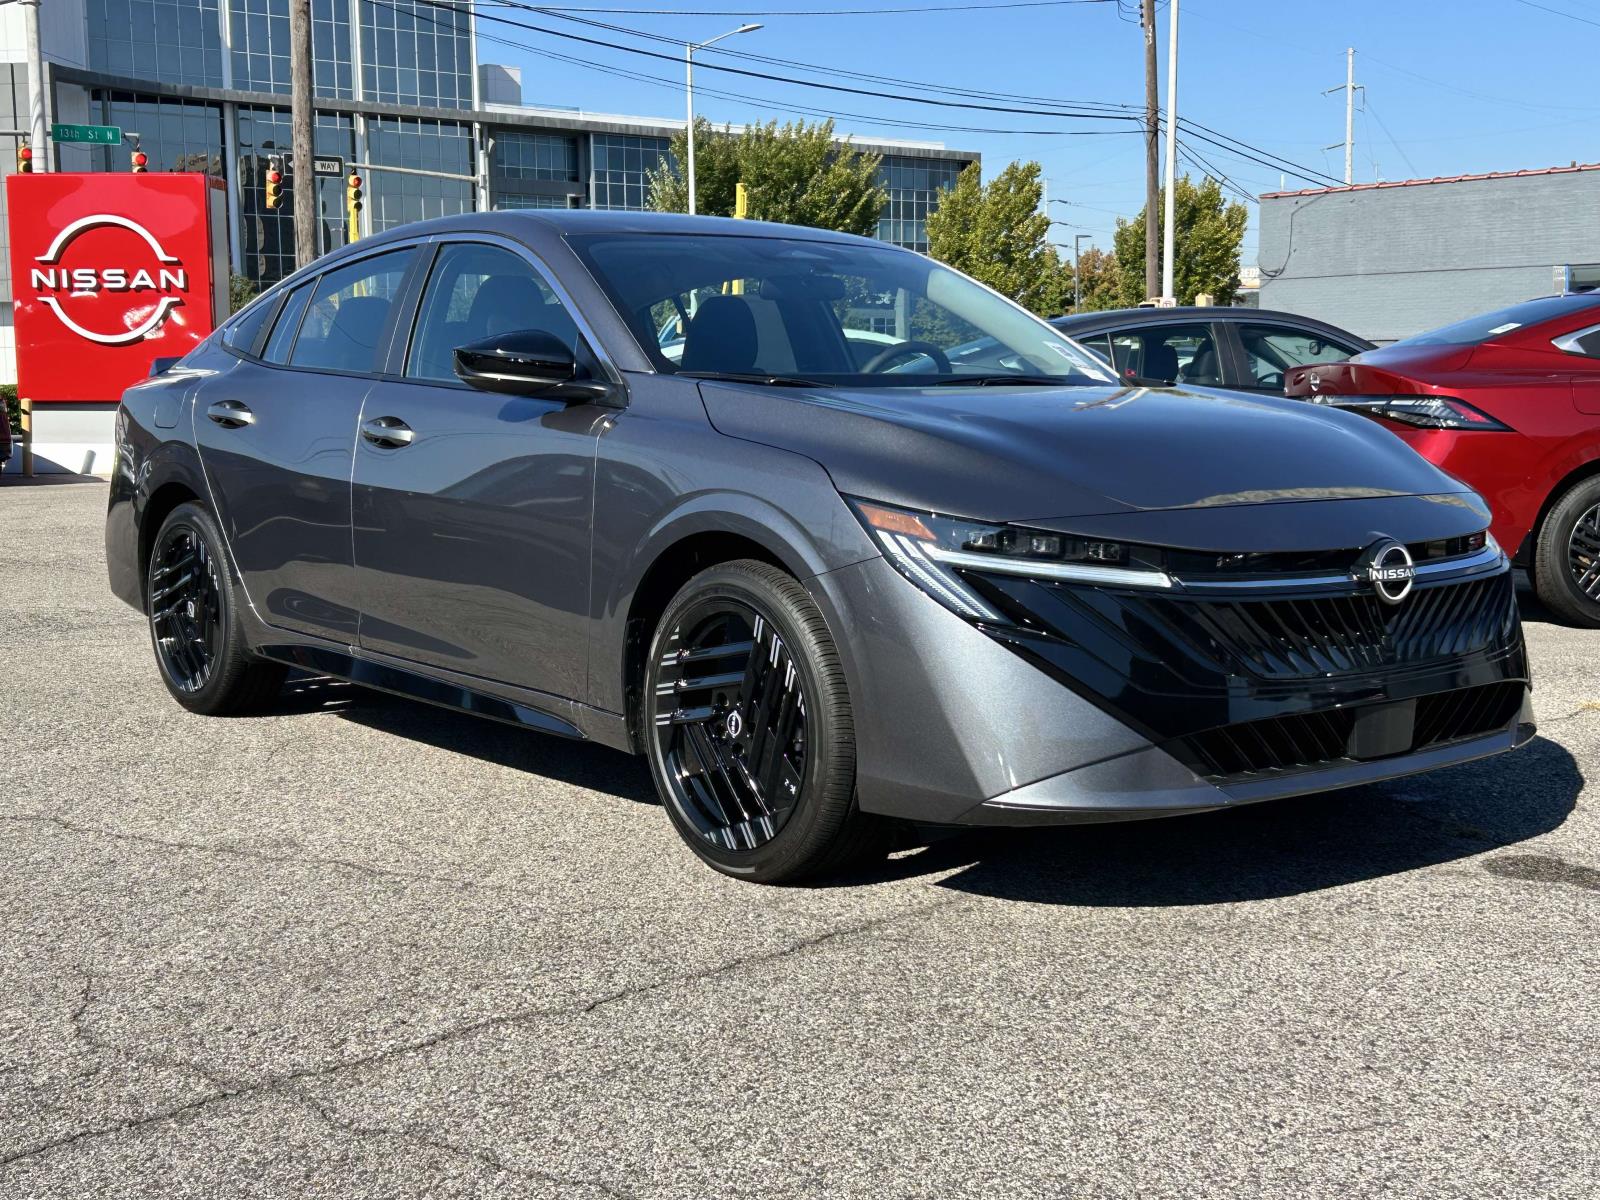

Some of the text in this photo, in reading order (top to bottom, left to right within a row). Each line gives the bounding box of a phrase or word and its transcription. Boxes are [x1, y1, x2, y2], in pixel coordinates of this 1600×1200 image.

[60, 128, 113, 140] 13th St N
[320, 162, 336, 171] WAY
[31, 268, 185, 289] NISSAN
[1372, 568, 1416, 580] NISSAN
